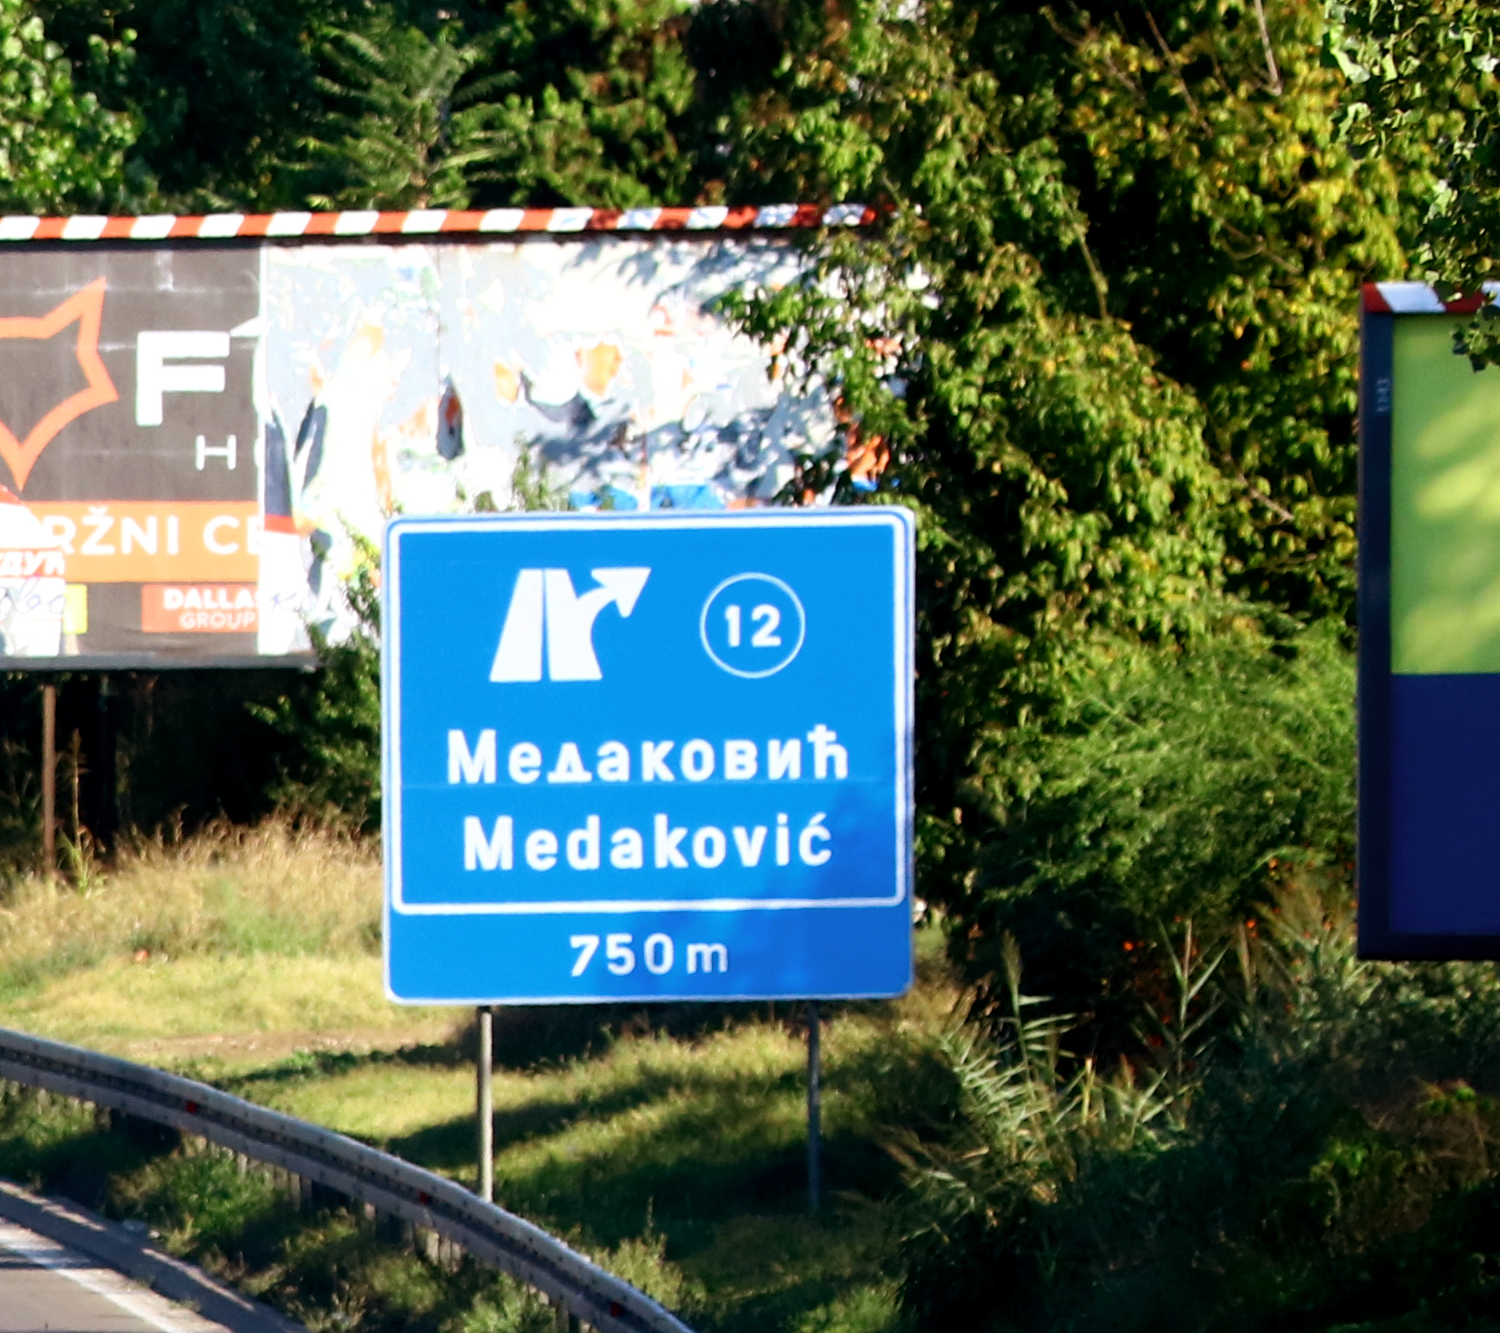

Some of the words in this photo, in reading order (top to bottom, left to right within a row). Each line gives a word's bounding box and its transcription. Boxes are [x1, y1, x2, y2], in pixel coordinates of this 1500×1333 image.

[162, 587, 259, 611] DALLA
[724, 604, 782, 648] 12
[447, 723, 849, 784] Медаковић
[463, 812, 833, 872] Medaković
[570, 933, 674, 978] 750
[686, 941, 729, 973] m
